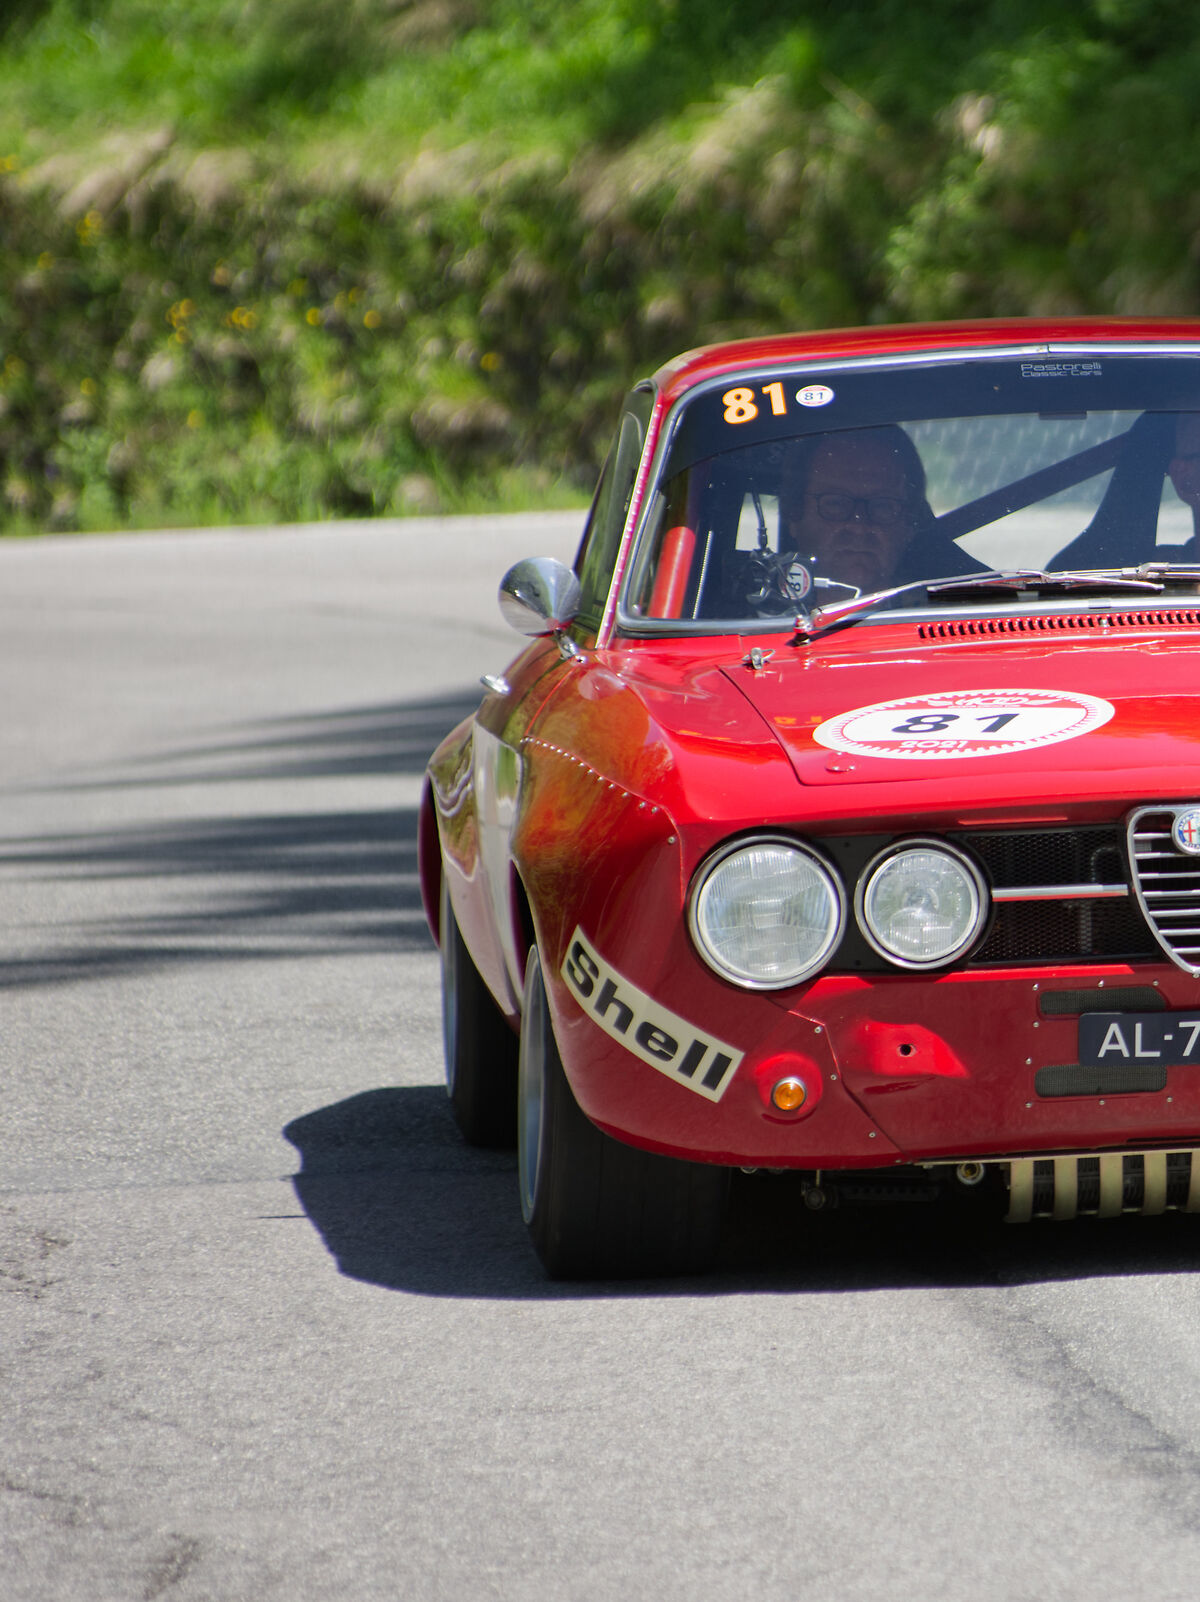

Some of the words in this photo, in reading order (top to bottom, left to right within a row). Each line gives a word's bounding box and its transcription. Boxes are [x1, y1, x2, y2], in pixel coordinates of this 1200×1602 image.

[1020, 362, 1102, 371] Pastorelli
[1022, 370, 1068, 378] Classic
[804, 391, 824, 401] 81
[722, 381, 788, 424] 81
[891, 713, 1020, 734] 81
[899, 740, 969, 749] 2021
[566, 940, 733, 1092] Shell
